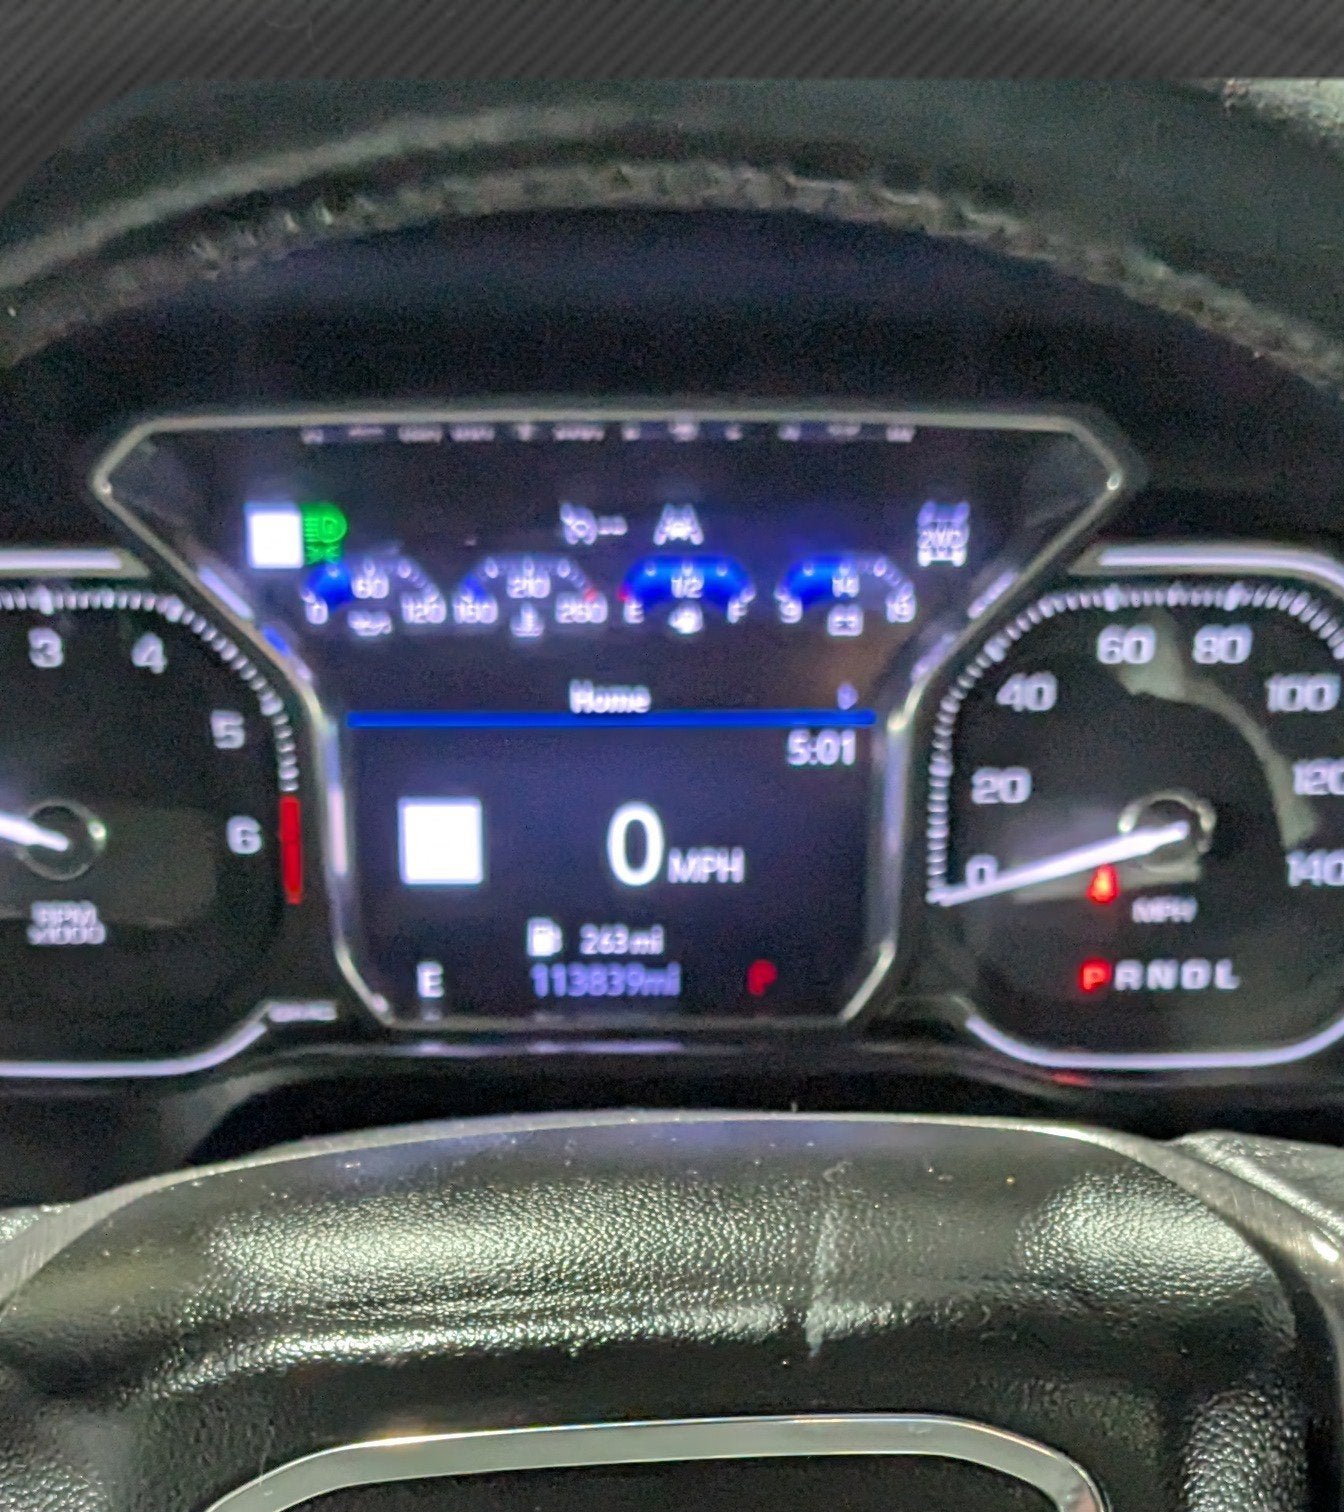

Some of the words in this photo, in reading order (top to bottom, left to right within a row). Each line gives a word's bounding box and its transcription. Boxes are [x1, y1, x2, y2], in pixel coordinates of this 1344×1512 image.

[624, 600, 645, 624] E
[28, 627, 64, 668] 3
[132, 633, 167, 675] 4
[1097, 625, 1156, 664] 60
[1193, 625, 1252, 664] 80
[570, 680, 651, 713] Home
[997, 672, 1057, 712] 40
[1265, 673, 1341, 712] 100
[211, 710, 245, 750] 5
[787, 730, 857, 766] 5:01
[971, 767, 1032, 805] 20
[226, 815, 263, 855] 6
[607, 801, 665, 886] 0
[668, 847, 746, 884] MPH
[966, 854, 998, 890] 0
[417, 960, 444, 998] E
